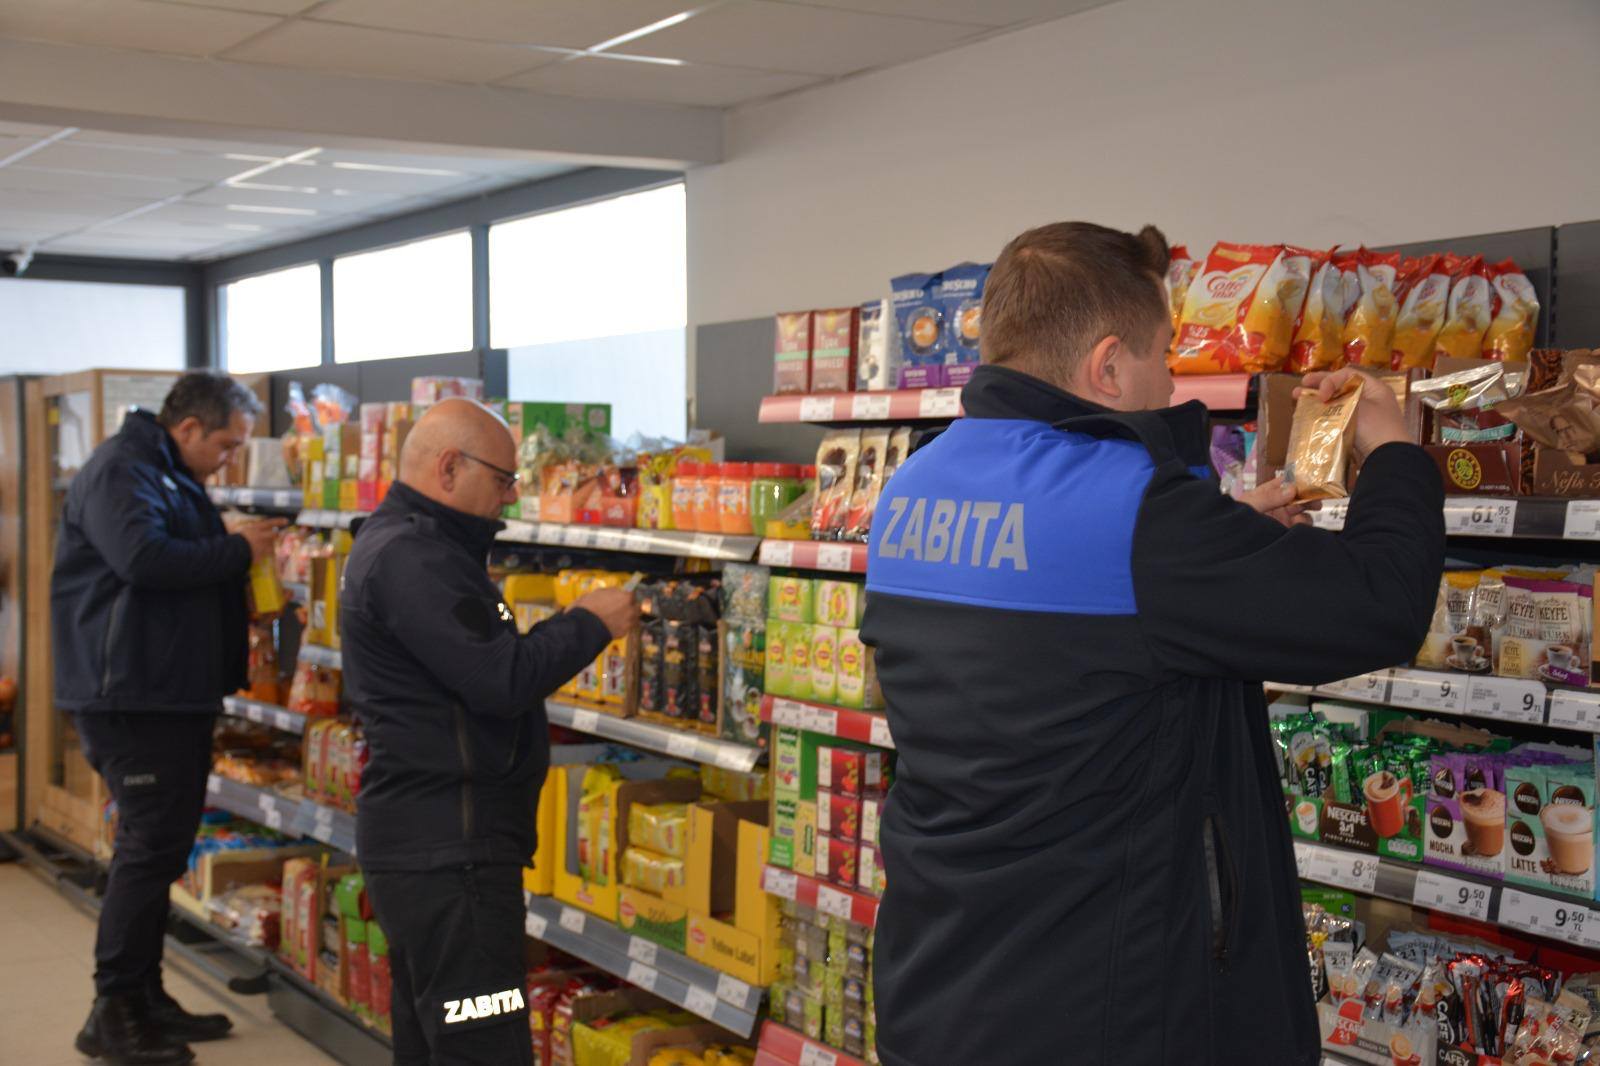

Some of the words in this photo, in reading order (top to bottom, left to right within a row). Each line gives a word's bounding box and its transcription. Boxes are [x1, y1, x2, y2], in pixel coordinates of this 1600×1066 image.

[878, 496, 1029, 571] ZABITA
[1509, 602, 1535, 619] KEYFE
[1539, 605, 1568, 621] KEYFE
[1440, 681, 1451, 698] 9
[1522, 693, 1534, 711] 9
[1429, 839, 1455, 855] MOCHA
[1511, 857, 1538, 874] LATTE
[1458, 886, 1486, 905] 9,50
[1555, 908, 1585, 927] 9,50
[443, 988, 525, 1024] ZABITA
